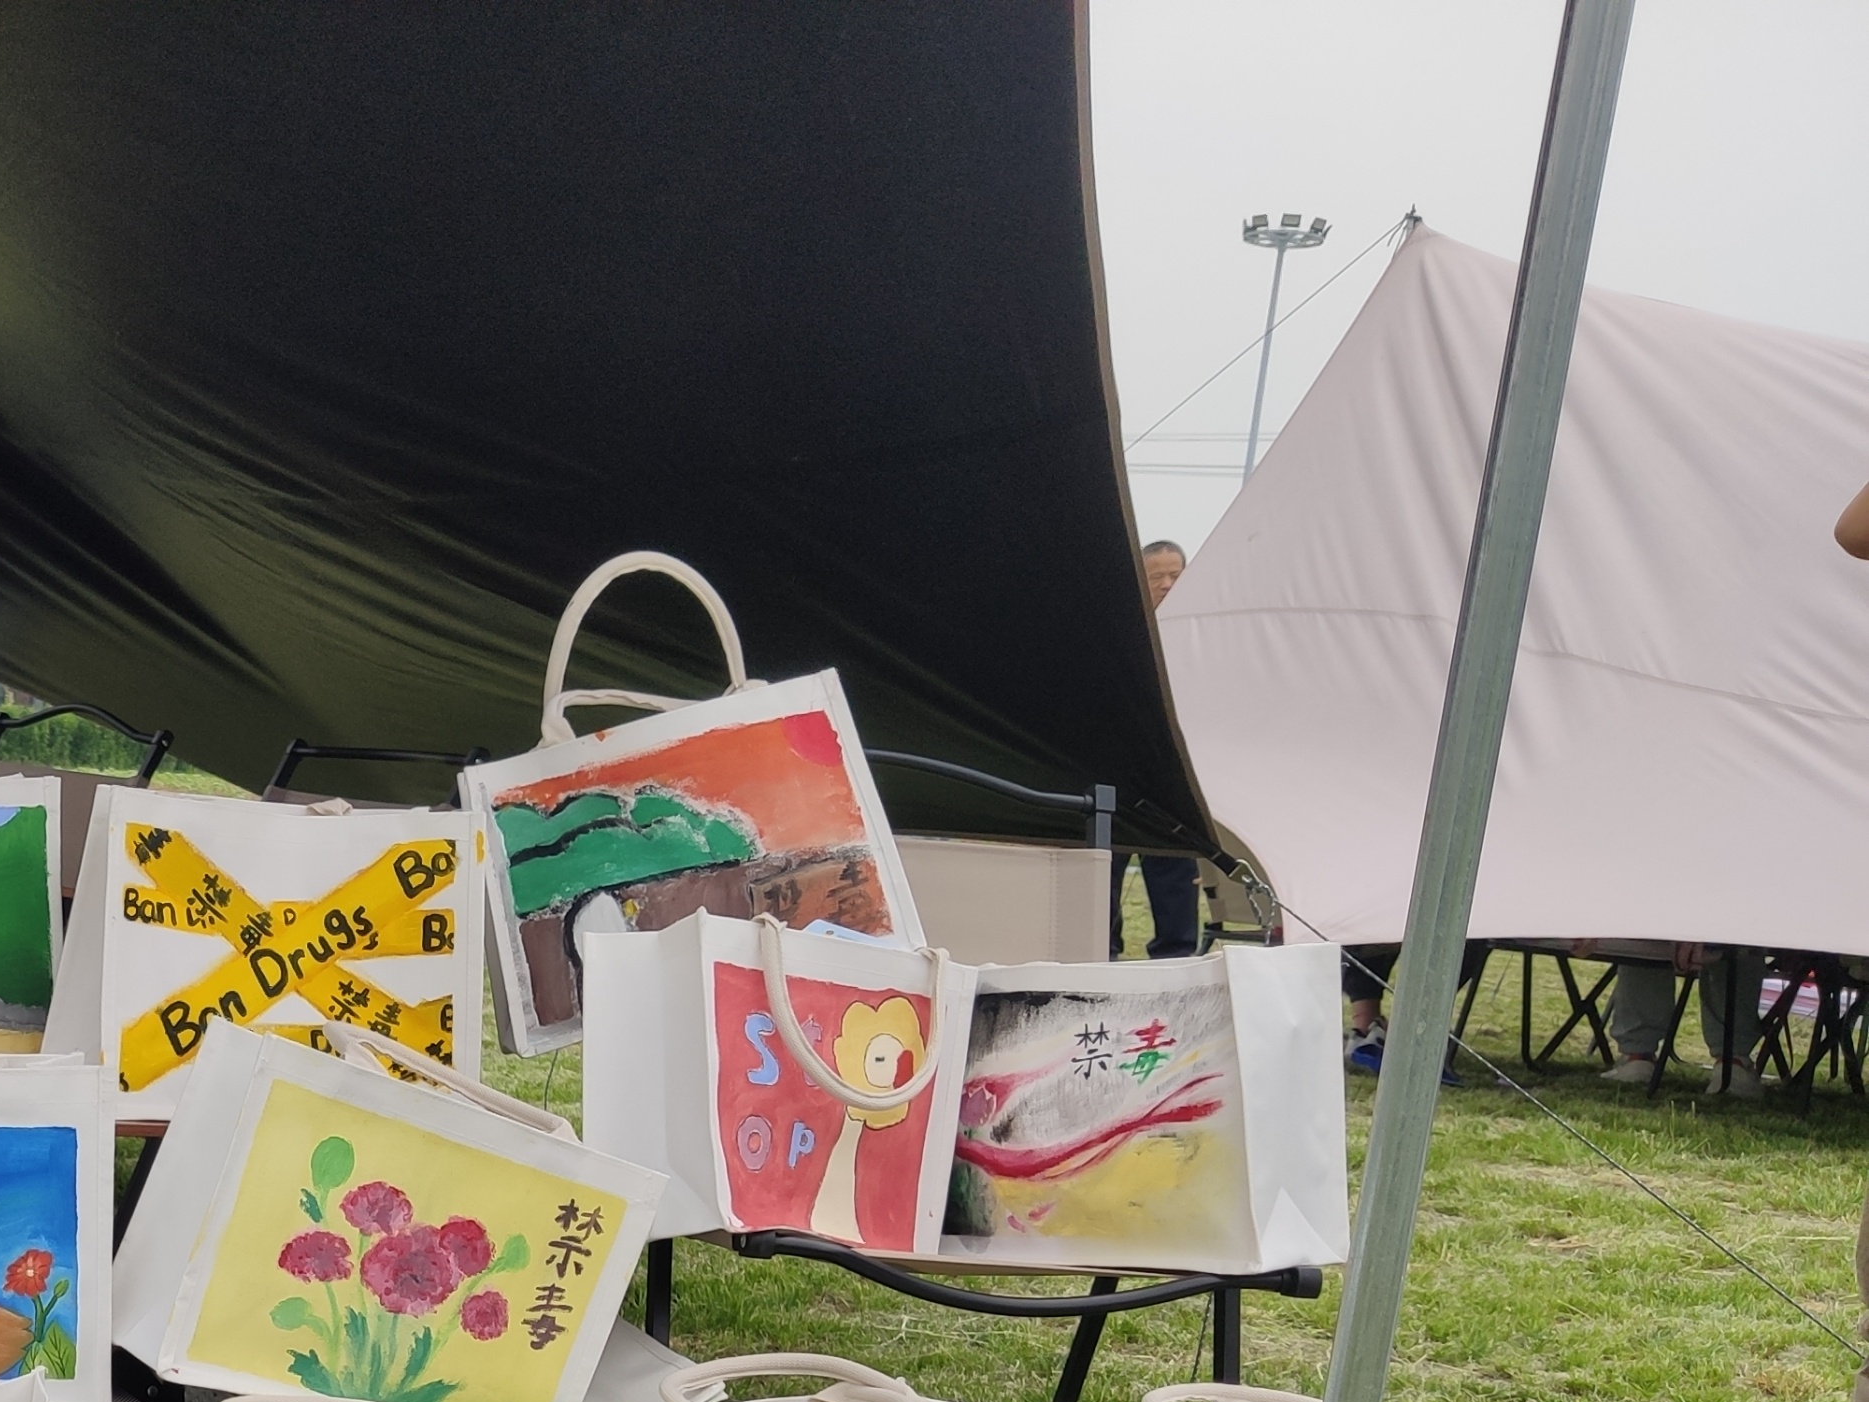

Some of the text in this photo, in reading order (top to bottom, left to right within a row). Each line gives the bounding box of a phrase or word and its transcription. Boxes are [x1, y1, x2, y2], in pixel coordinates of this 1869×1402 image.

[124, 887, 178, 926] Ban
[249, 905, 374, 999] Drugs
[1071, 1018, 1177, 1086] 禁毒
[521, 1198, 605, 1350] 禁毒
